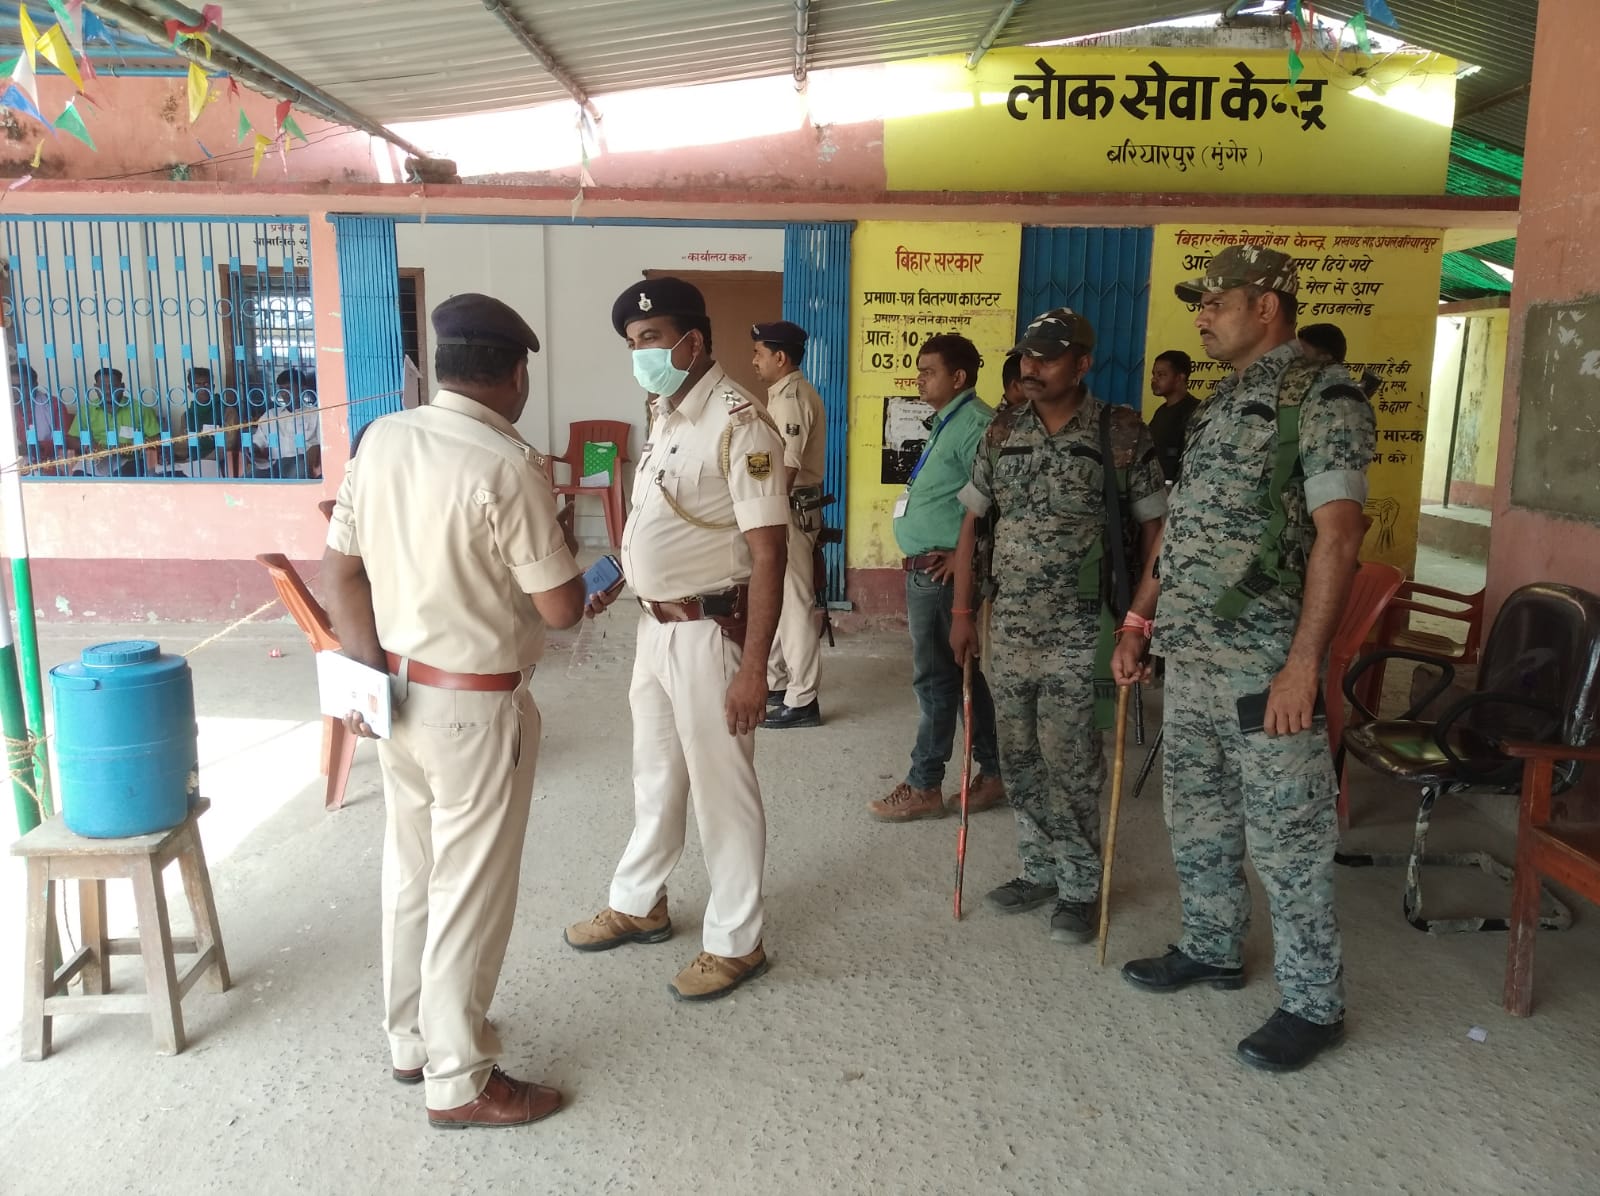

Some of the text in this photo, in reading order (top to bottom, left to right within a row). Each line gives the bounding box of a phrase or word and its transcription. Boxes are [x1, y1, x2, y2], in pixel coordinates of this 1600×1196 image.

[1007, 58, 1116, 121] लोक
[1119, 61, 1220, 121] सेवा
[1106, 138, 1196, 172] बरियारपुर
[1174, 229, 1213, 249] बिहार
[1211, 230, 1237, 246] लोक
[1294, 232, 1327, 251] केन्द्र
[895, 245, 984, 275] बिहार सरकार
[1321, 254, 1349, 272] दिये
[1349, 254, 1374, 272] गये
[1333, 278, 1350, 295] से
[1351, 282, 1384, 296] आप
[918, 288, 958, 307] वितरण
[1311, 298, 1375, 316] डाउनलोड
[1383, 430, 1424, 442] मास्क
